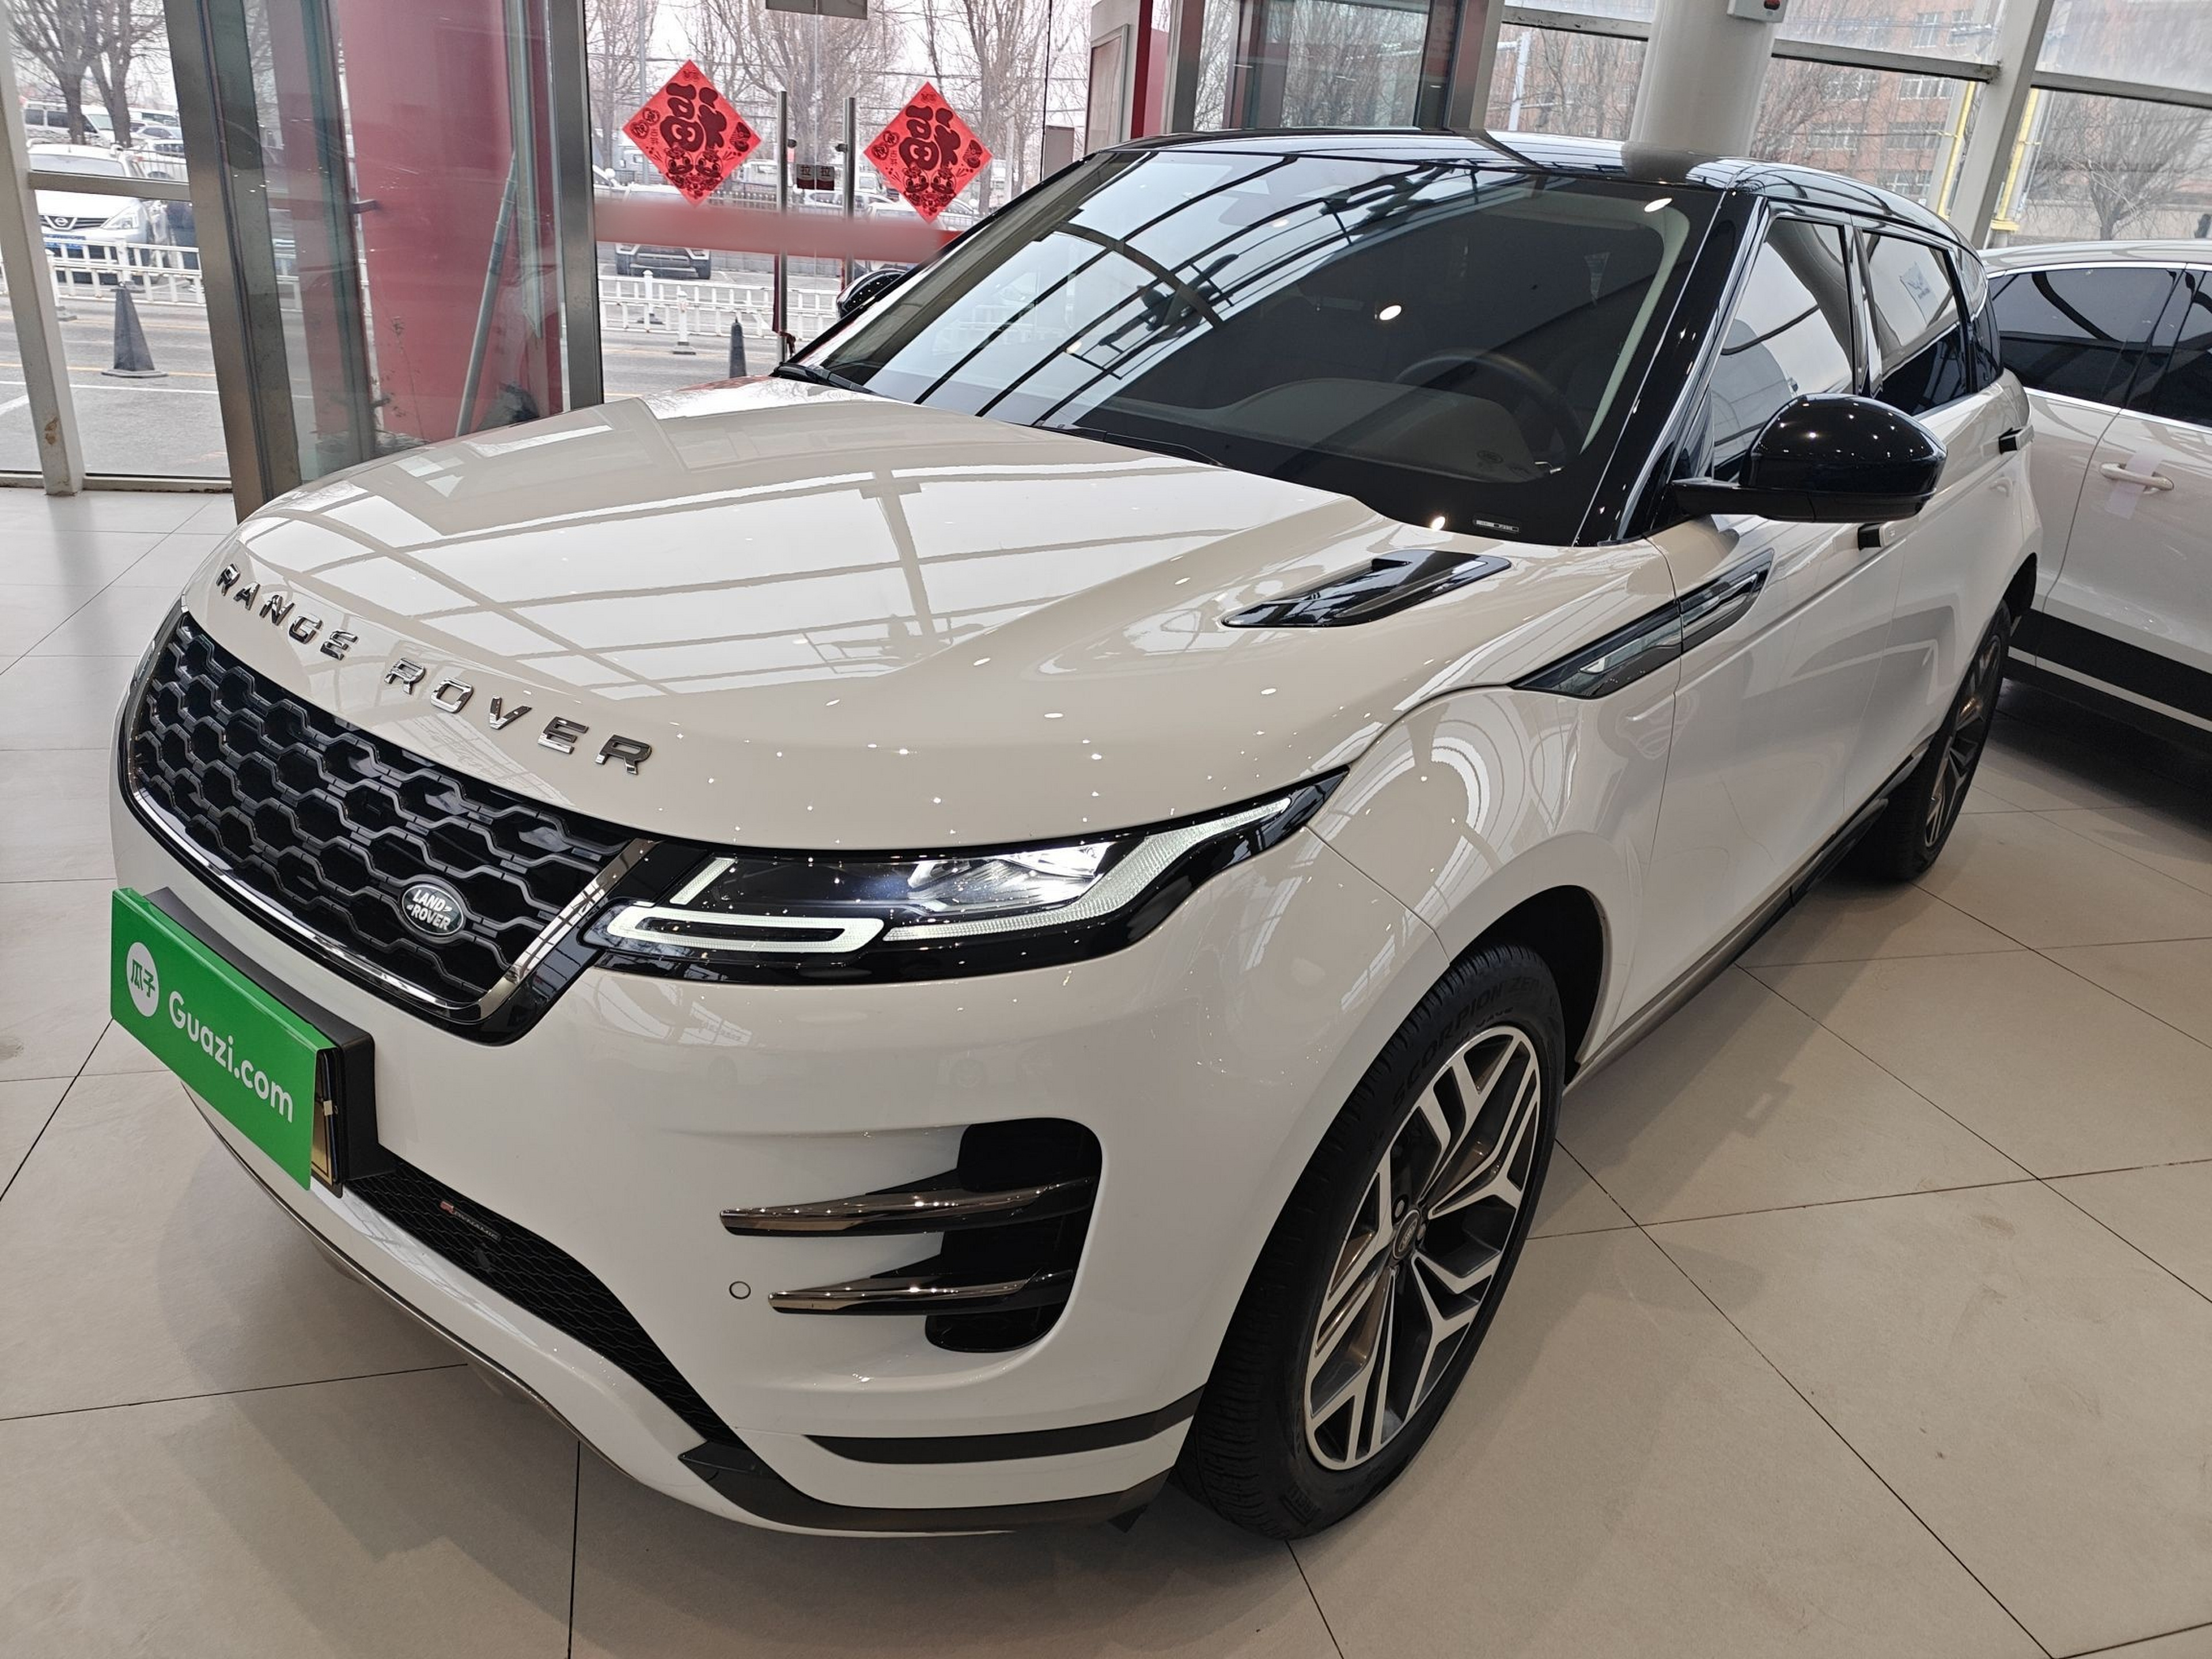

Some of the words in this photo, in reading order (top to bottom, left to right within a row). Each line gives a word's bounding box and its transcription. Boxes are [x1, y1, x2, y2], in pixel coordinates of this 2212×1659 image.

[660, 82, 727, 153] 福
[899, 105, 961, 171] 福
[801, 165, 812, 176] 拉
[820, 166, 831, 177] 拉
[215, 563, 359, 661] RANGE
[384, 656, 653, 775] ROVER
[411, 904, 451, 930] ROVER
[412, 889, 446, 912] LAND
[130, 959, 156, 998] 瓜子
[168, 990, 293, 1123] Guazi.com
